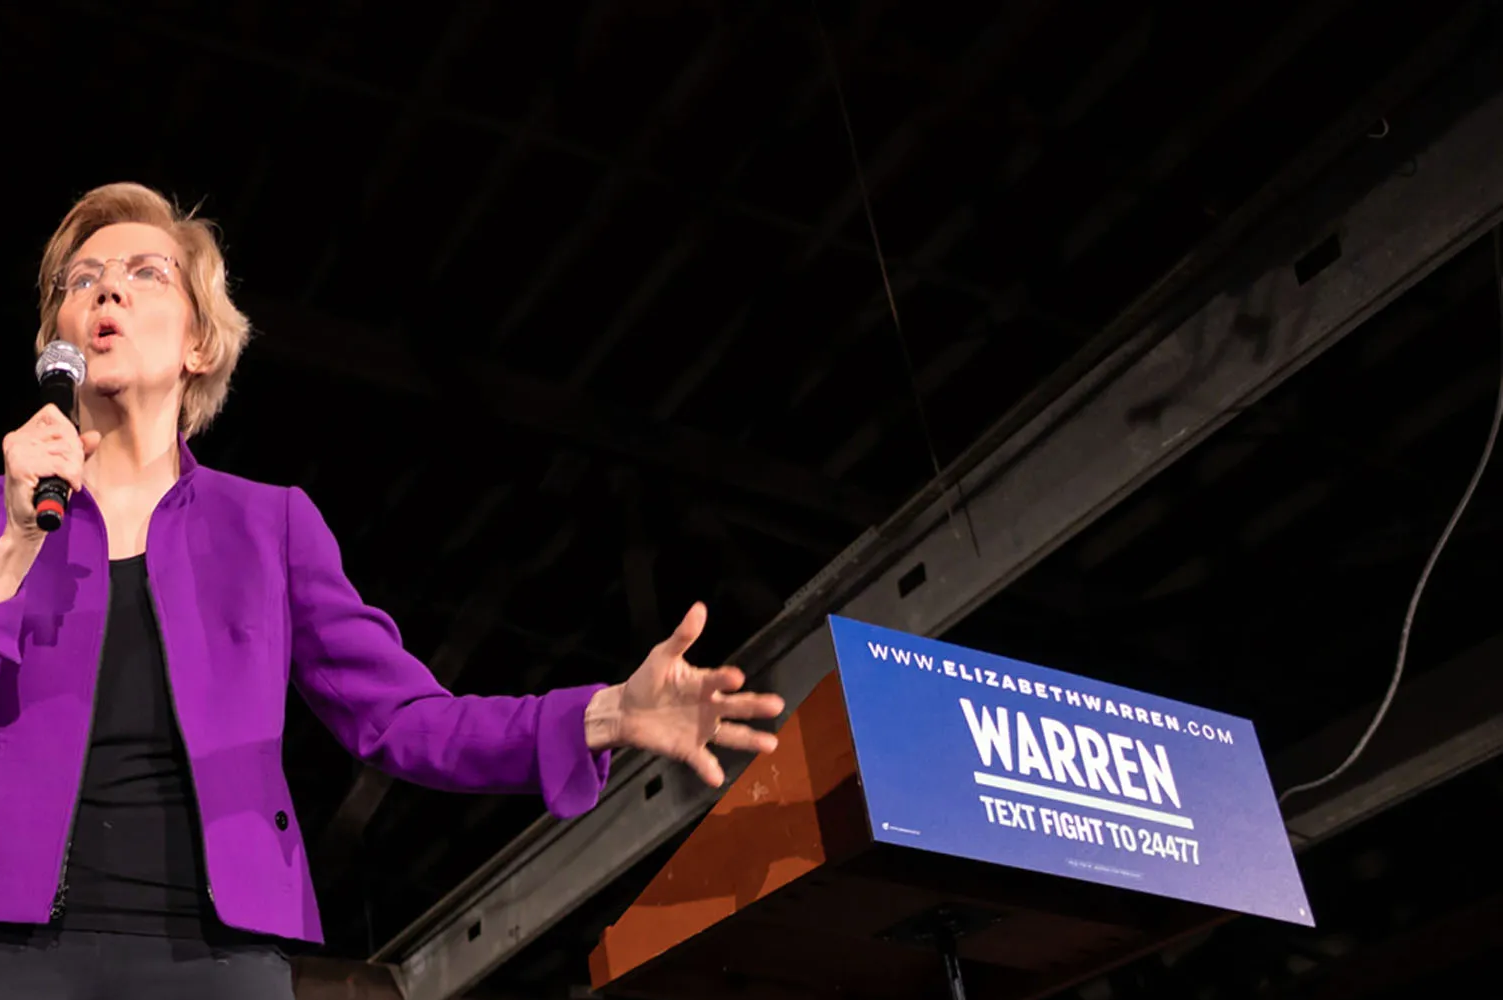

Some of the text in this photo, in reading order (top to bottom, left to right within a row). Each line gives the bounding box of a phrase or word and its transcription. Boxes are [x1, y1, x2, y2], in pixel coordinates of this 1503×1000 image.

[867, 641, 1234, 745] WWW.ELIZABETHWARREN.COM
[959, 697, 1182, 809] WARREN
[979, 795, 1200, 865] TEXT FIGHT TO 24477
